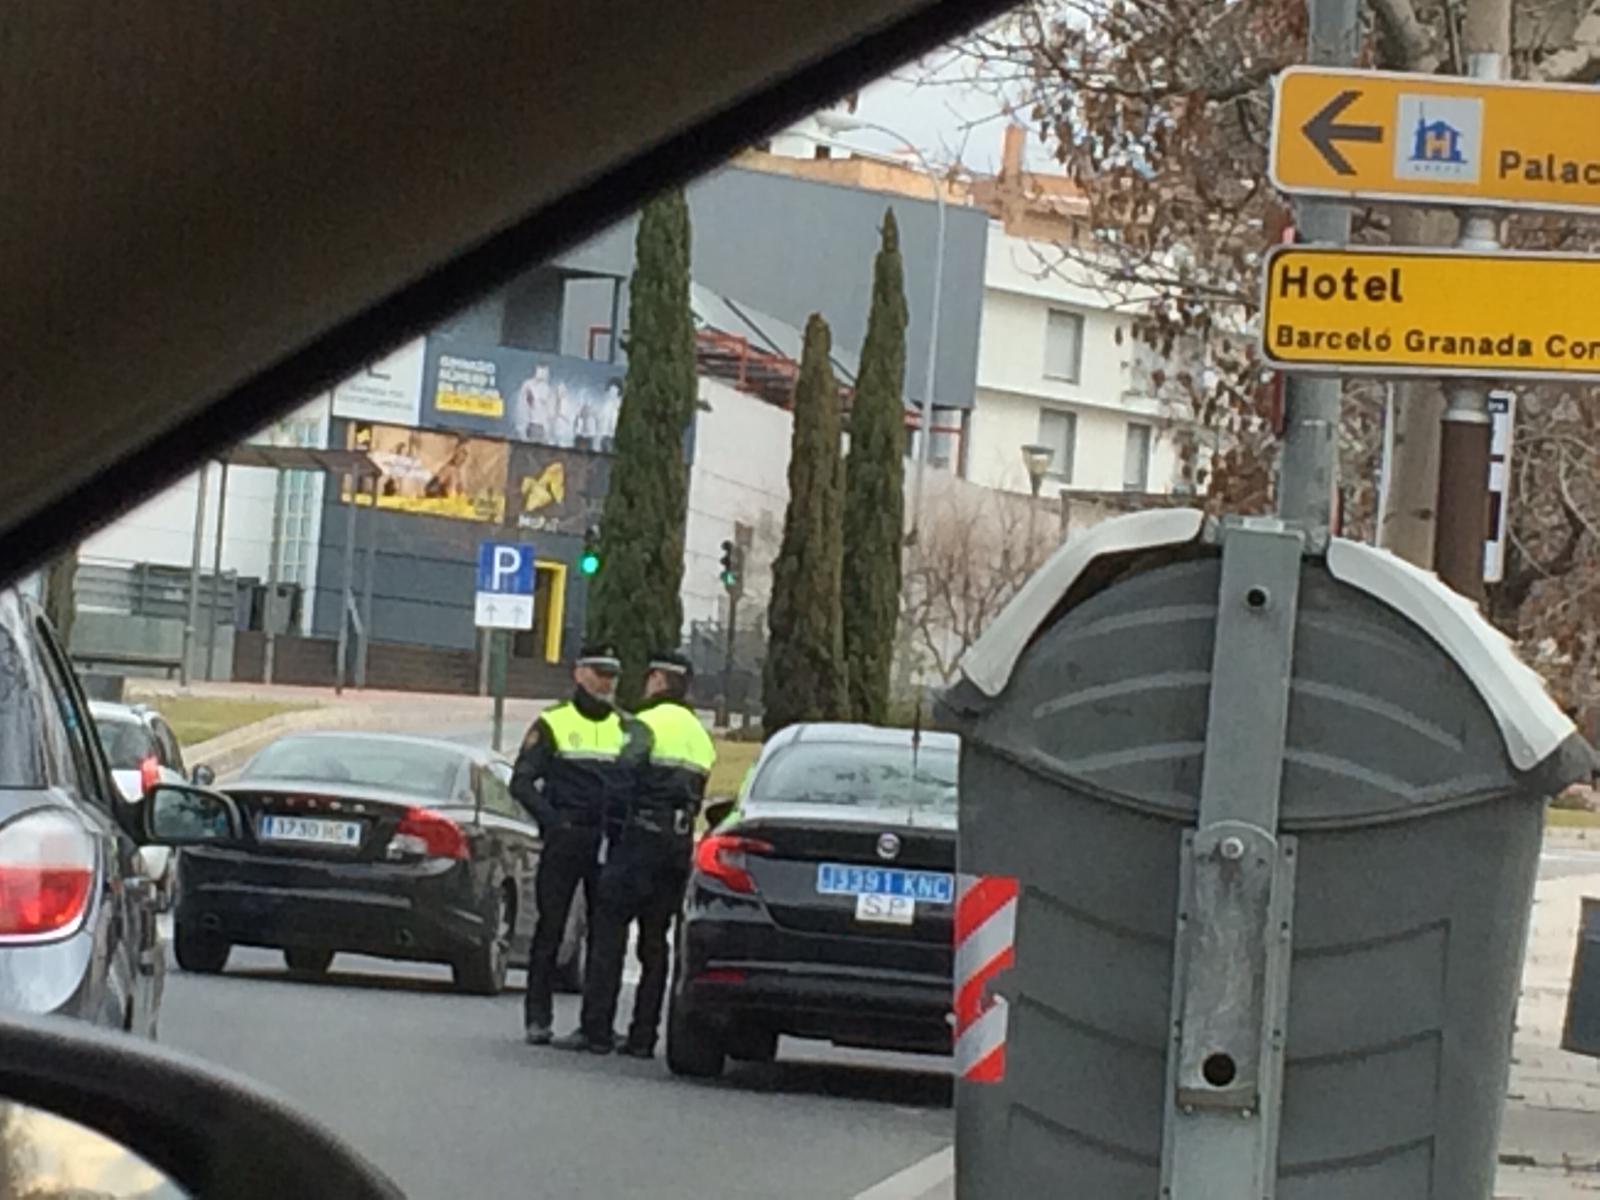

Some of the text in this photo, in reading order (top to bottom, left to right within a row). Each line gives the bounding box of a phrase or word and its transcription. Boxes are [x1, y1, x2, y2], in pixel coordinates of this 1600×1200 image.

[1499, 150, 1600, 186] Palac
[1279, 264, 1404, 303] Hotel
[1275, 324, 1392, 352] Barceló
[1404, 329, 1533, 357] Granada
[492, 546, 522, 591] P
